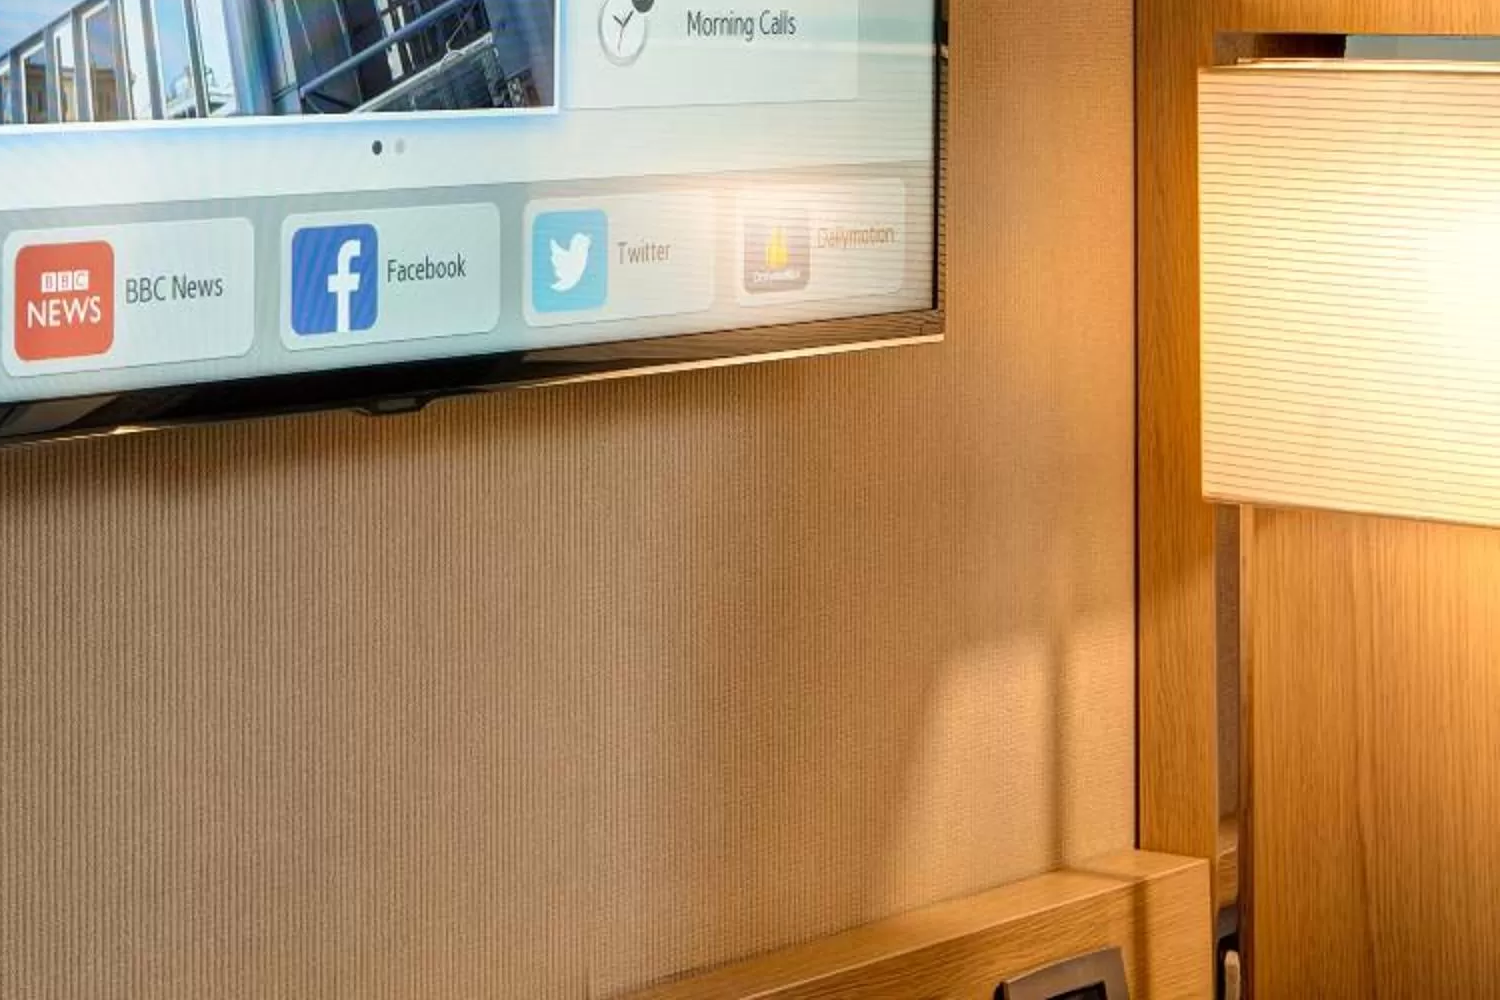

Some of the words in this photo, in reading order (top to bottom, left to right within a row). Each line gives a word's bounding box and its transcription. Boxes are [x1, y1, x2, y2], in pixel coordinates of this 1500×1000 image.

[686, 8, 755, 43] Morning
[759, 9, 797, 35] Calls
[386, 252, 467, 283] Facebook
[617, 240, 671, 266] Twitter
[125, 275, 166, 304] BBC
[171, 273, 224, 300] News
[26, 295, 102, 329] NEWS
